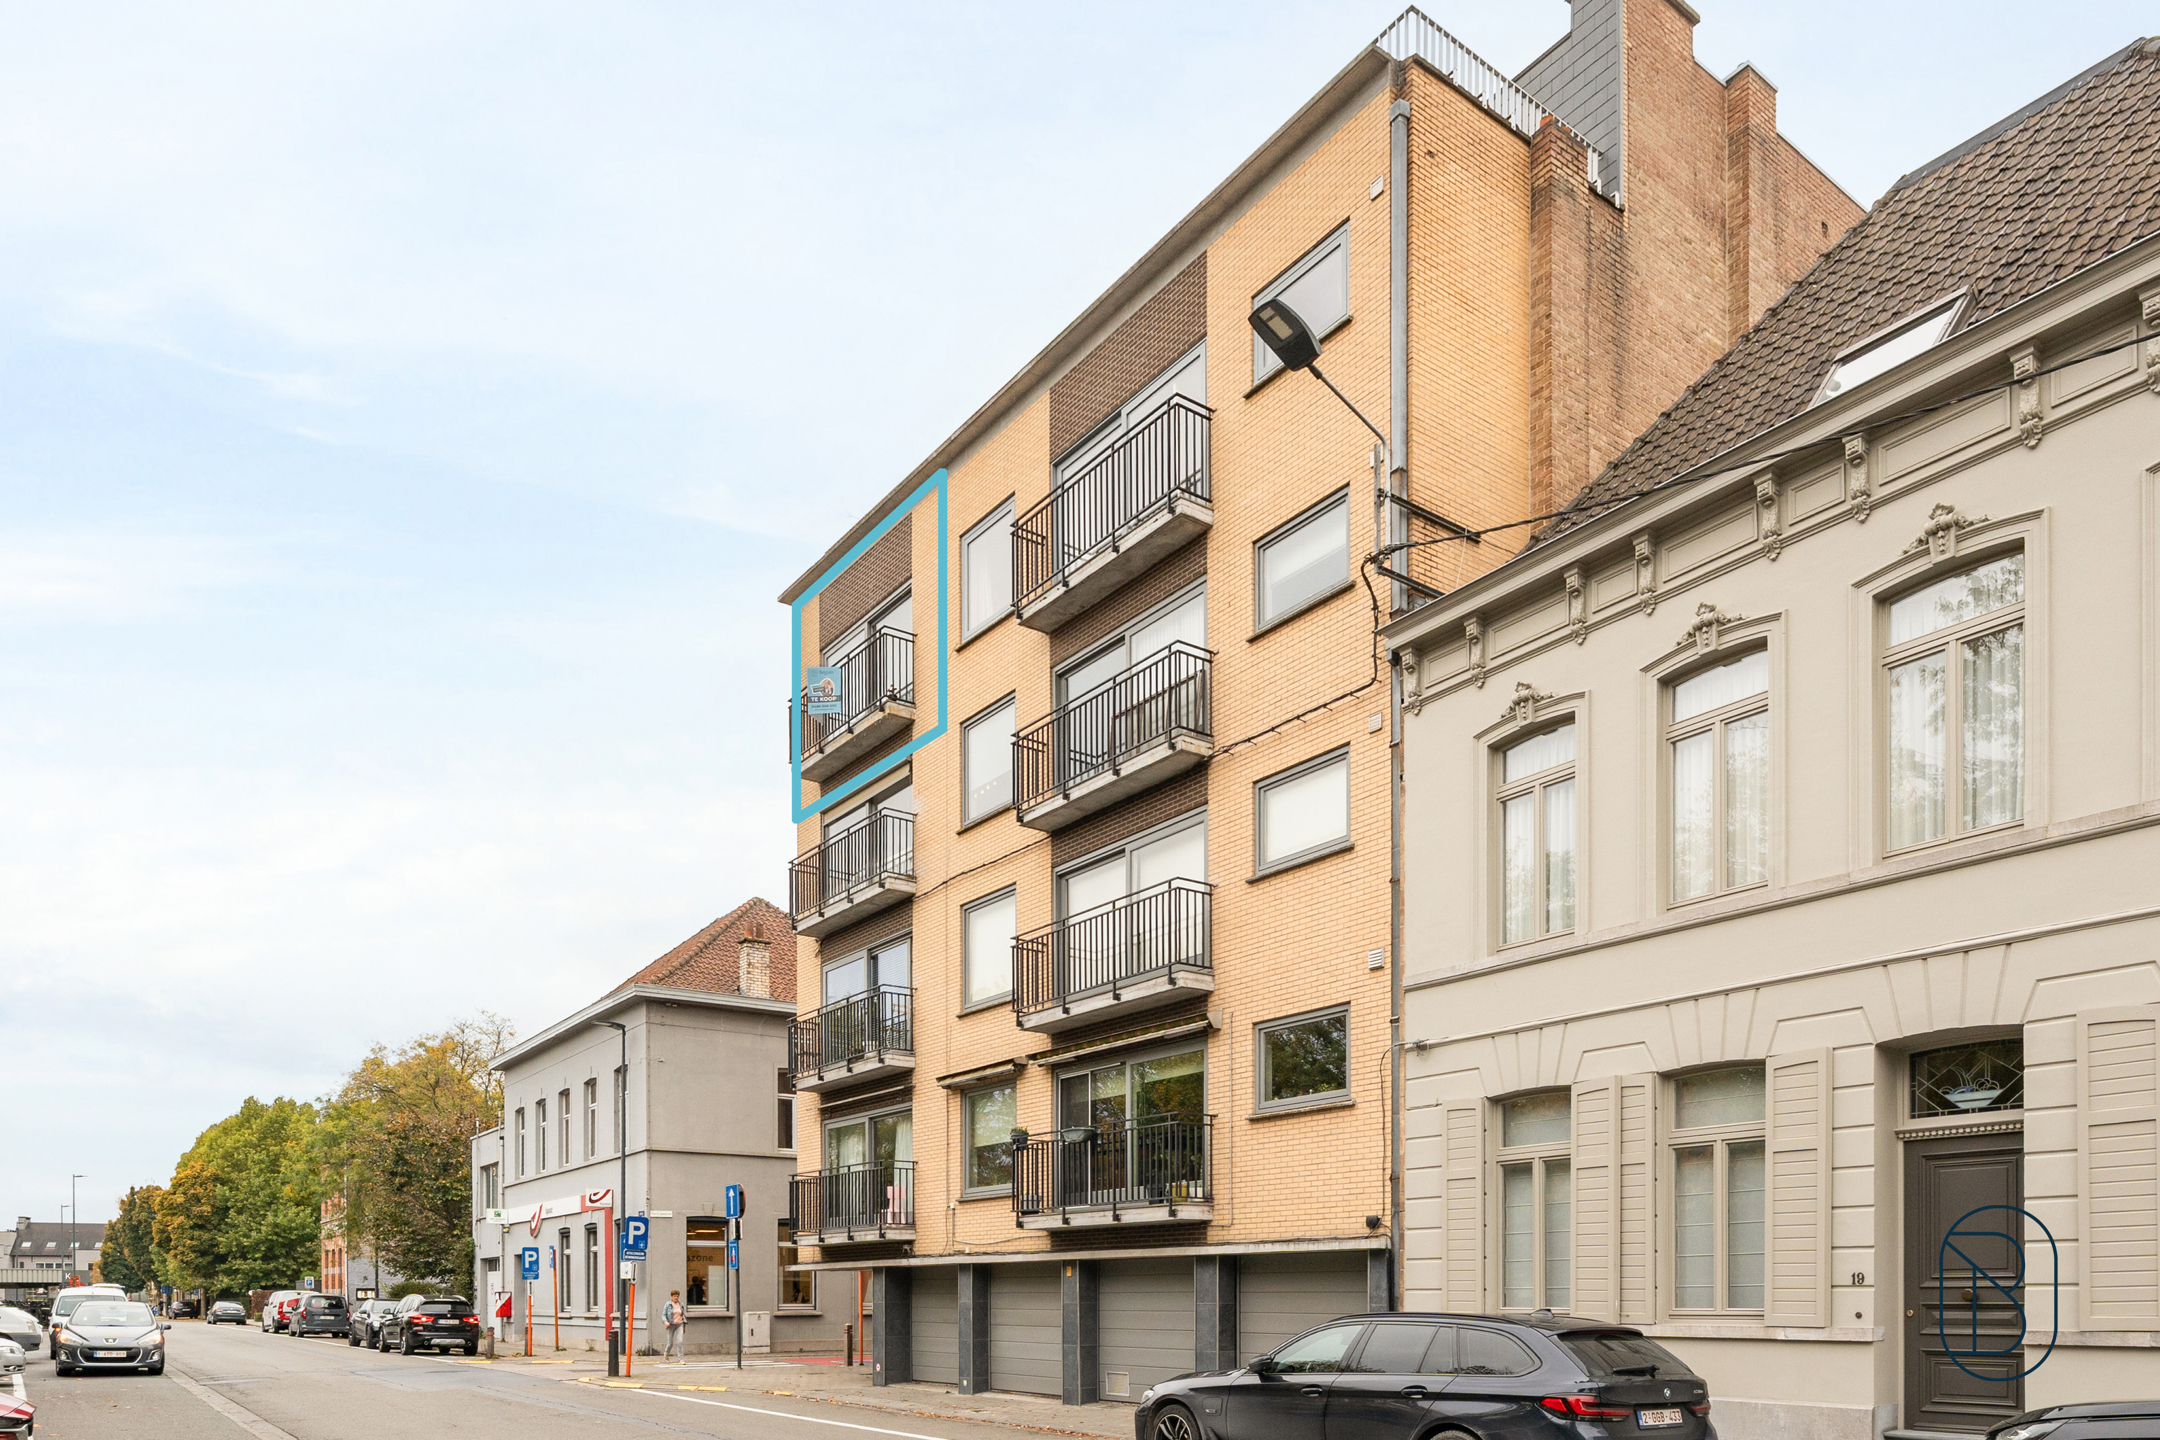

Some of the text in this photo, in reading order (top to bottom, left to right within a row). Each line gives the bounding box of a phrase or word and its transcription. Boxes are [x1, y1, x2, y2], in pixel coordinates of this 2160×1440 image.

[628, 1221, 646, 1245] P
[525, 1251, 538, 1268] P
[1851, 1272, 1865, 1285] 19
